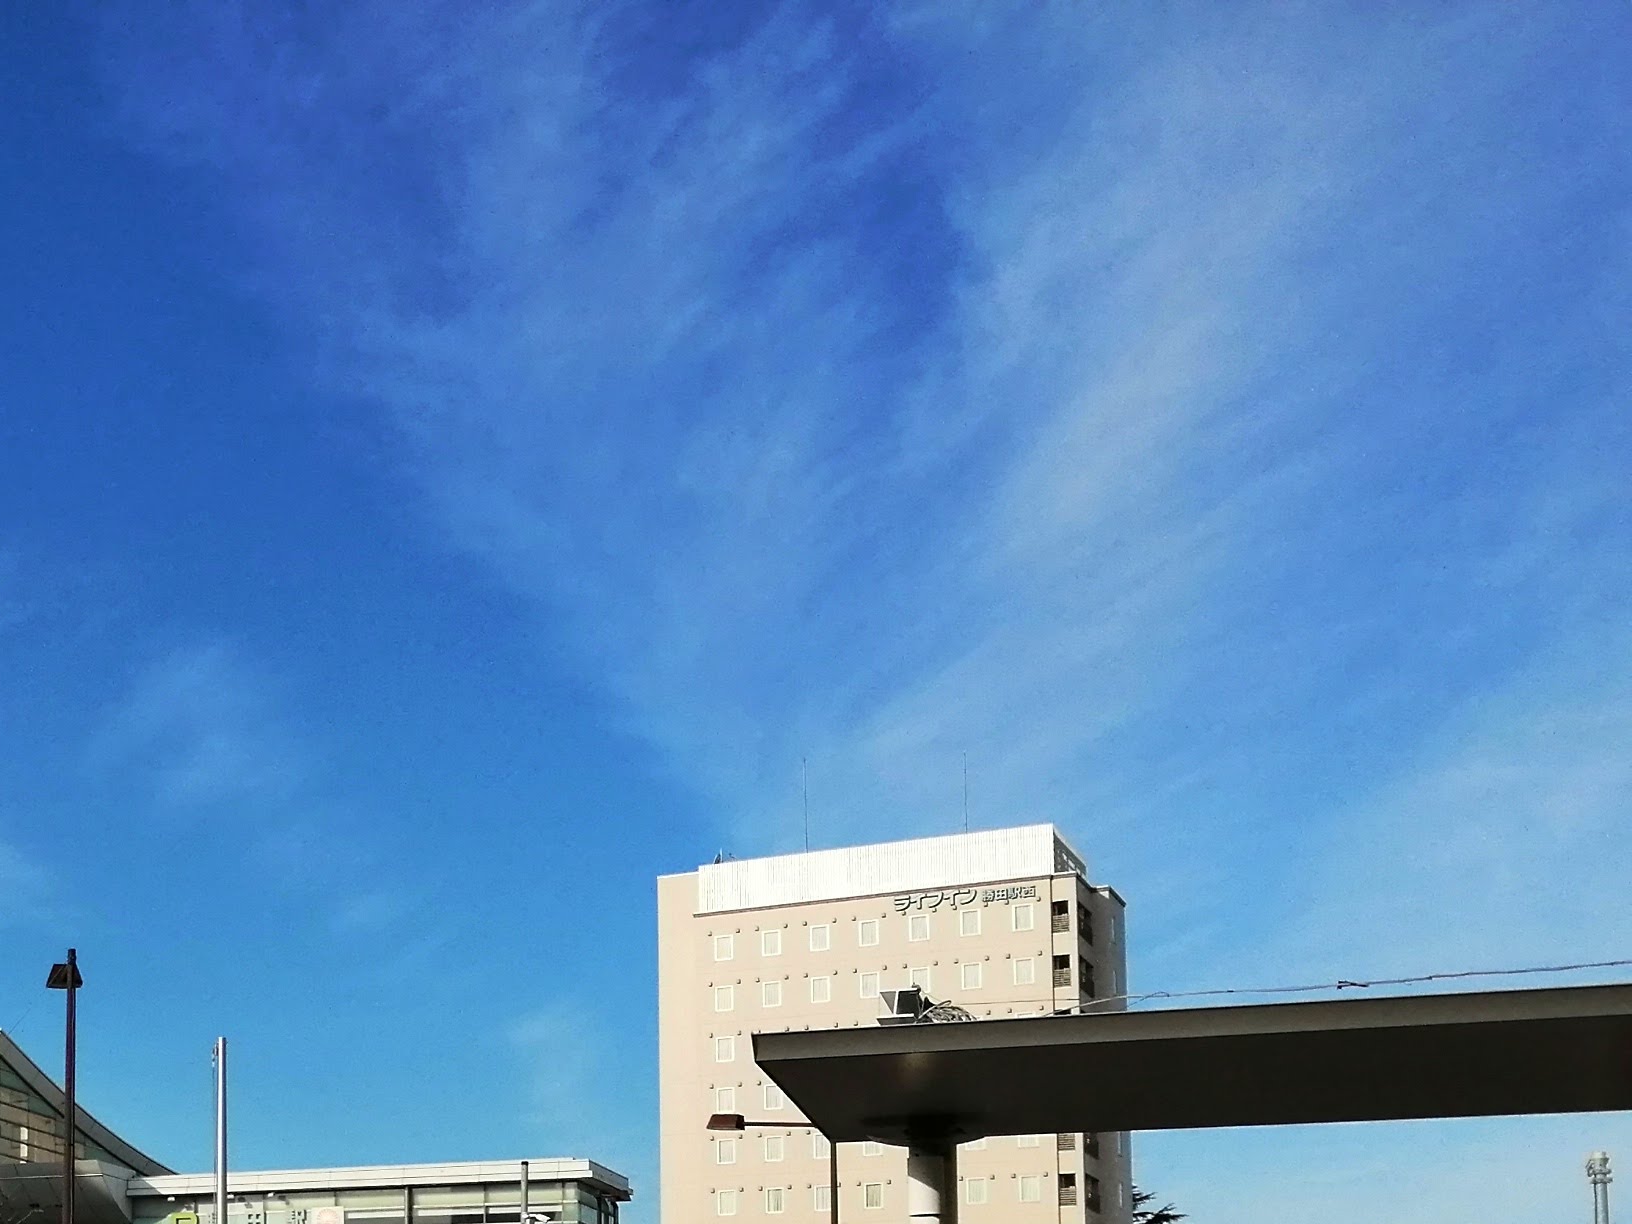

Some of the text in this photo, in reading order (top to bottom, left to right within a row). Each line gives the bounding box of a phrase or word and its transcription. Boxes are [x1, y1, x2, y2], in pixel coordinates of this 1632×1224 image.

[894, 889, 977, 912] ライフイン
